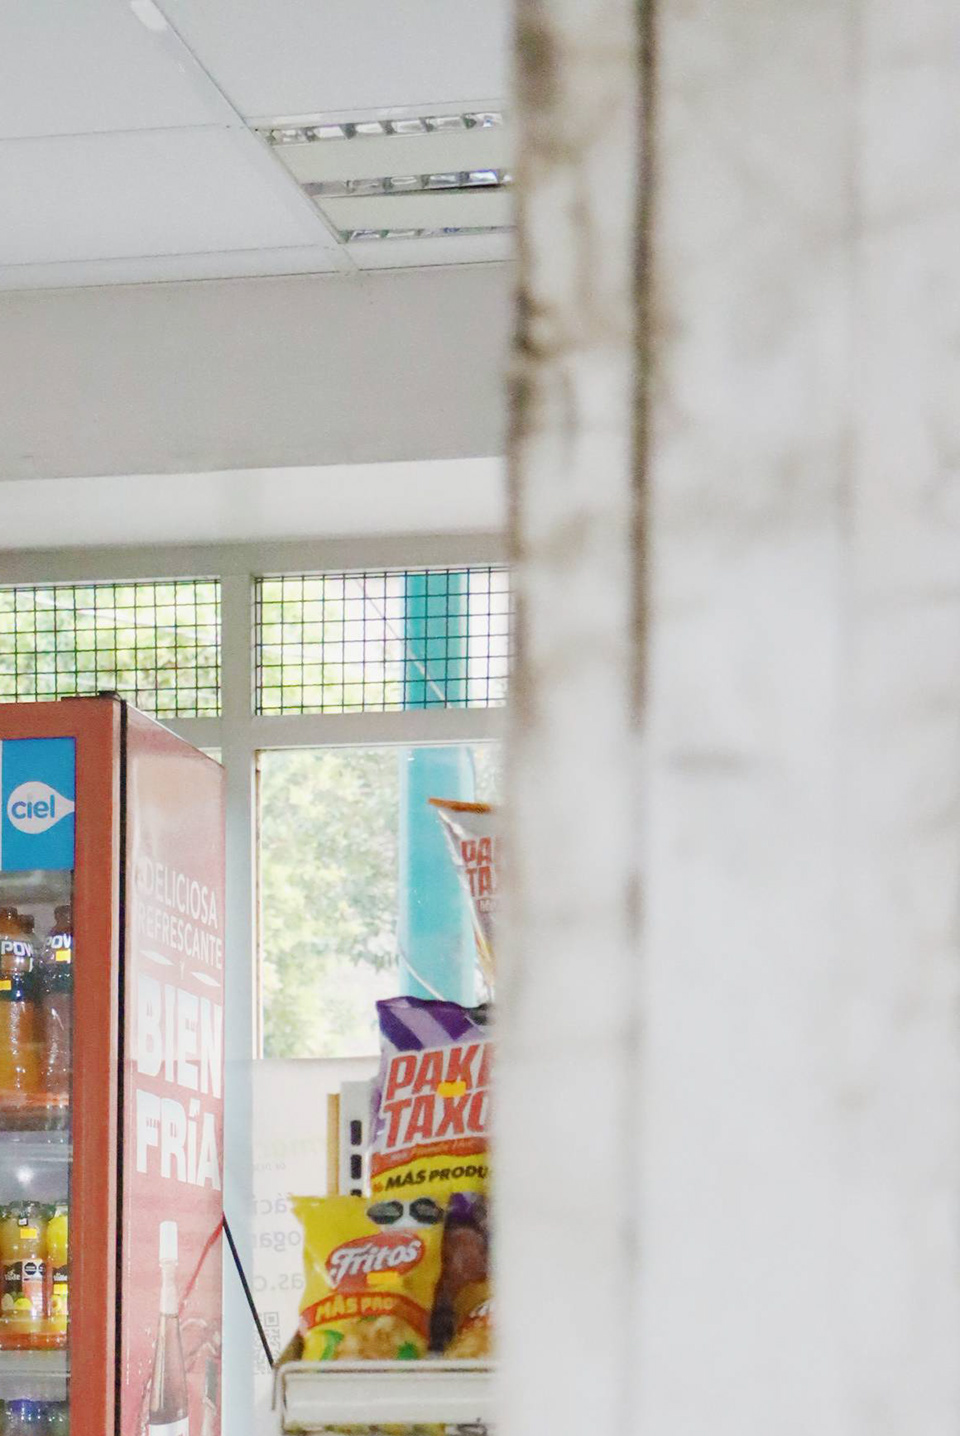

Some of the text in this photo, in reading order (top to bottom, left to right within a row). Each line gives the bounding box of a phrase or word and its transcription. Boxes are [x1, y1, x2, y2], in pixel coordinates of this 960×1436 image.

[11, 794, 57, 820] ciel
[138, 902, 223, 970] REFRESCANTE
[137, 972, 223, 1099] BIEN
[136, 1089, 222, 1191] FRÍA
[331, 1240, 423, 1289] Fritos
